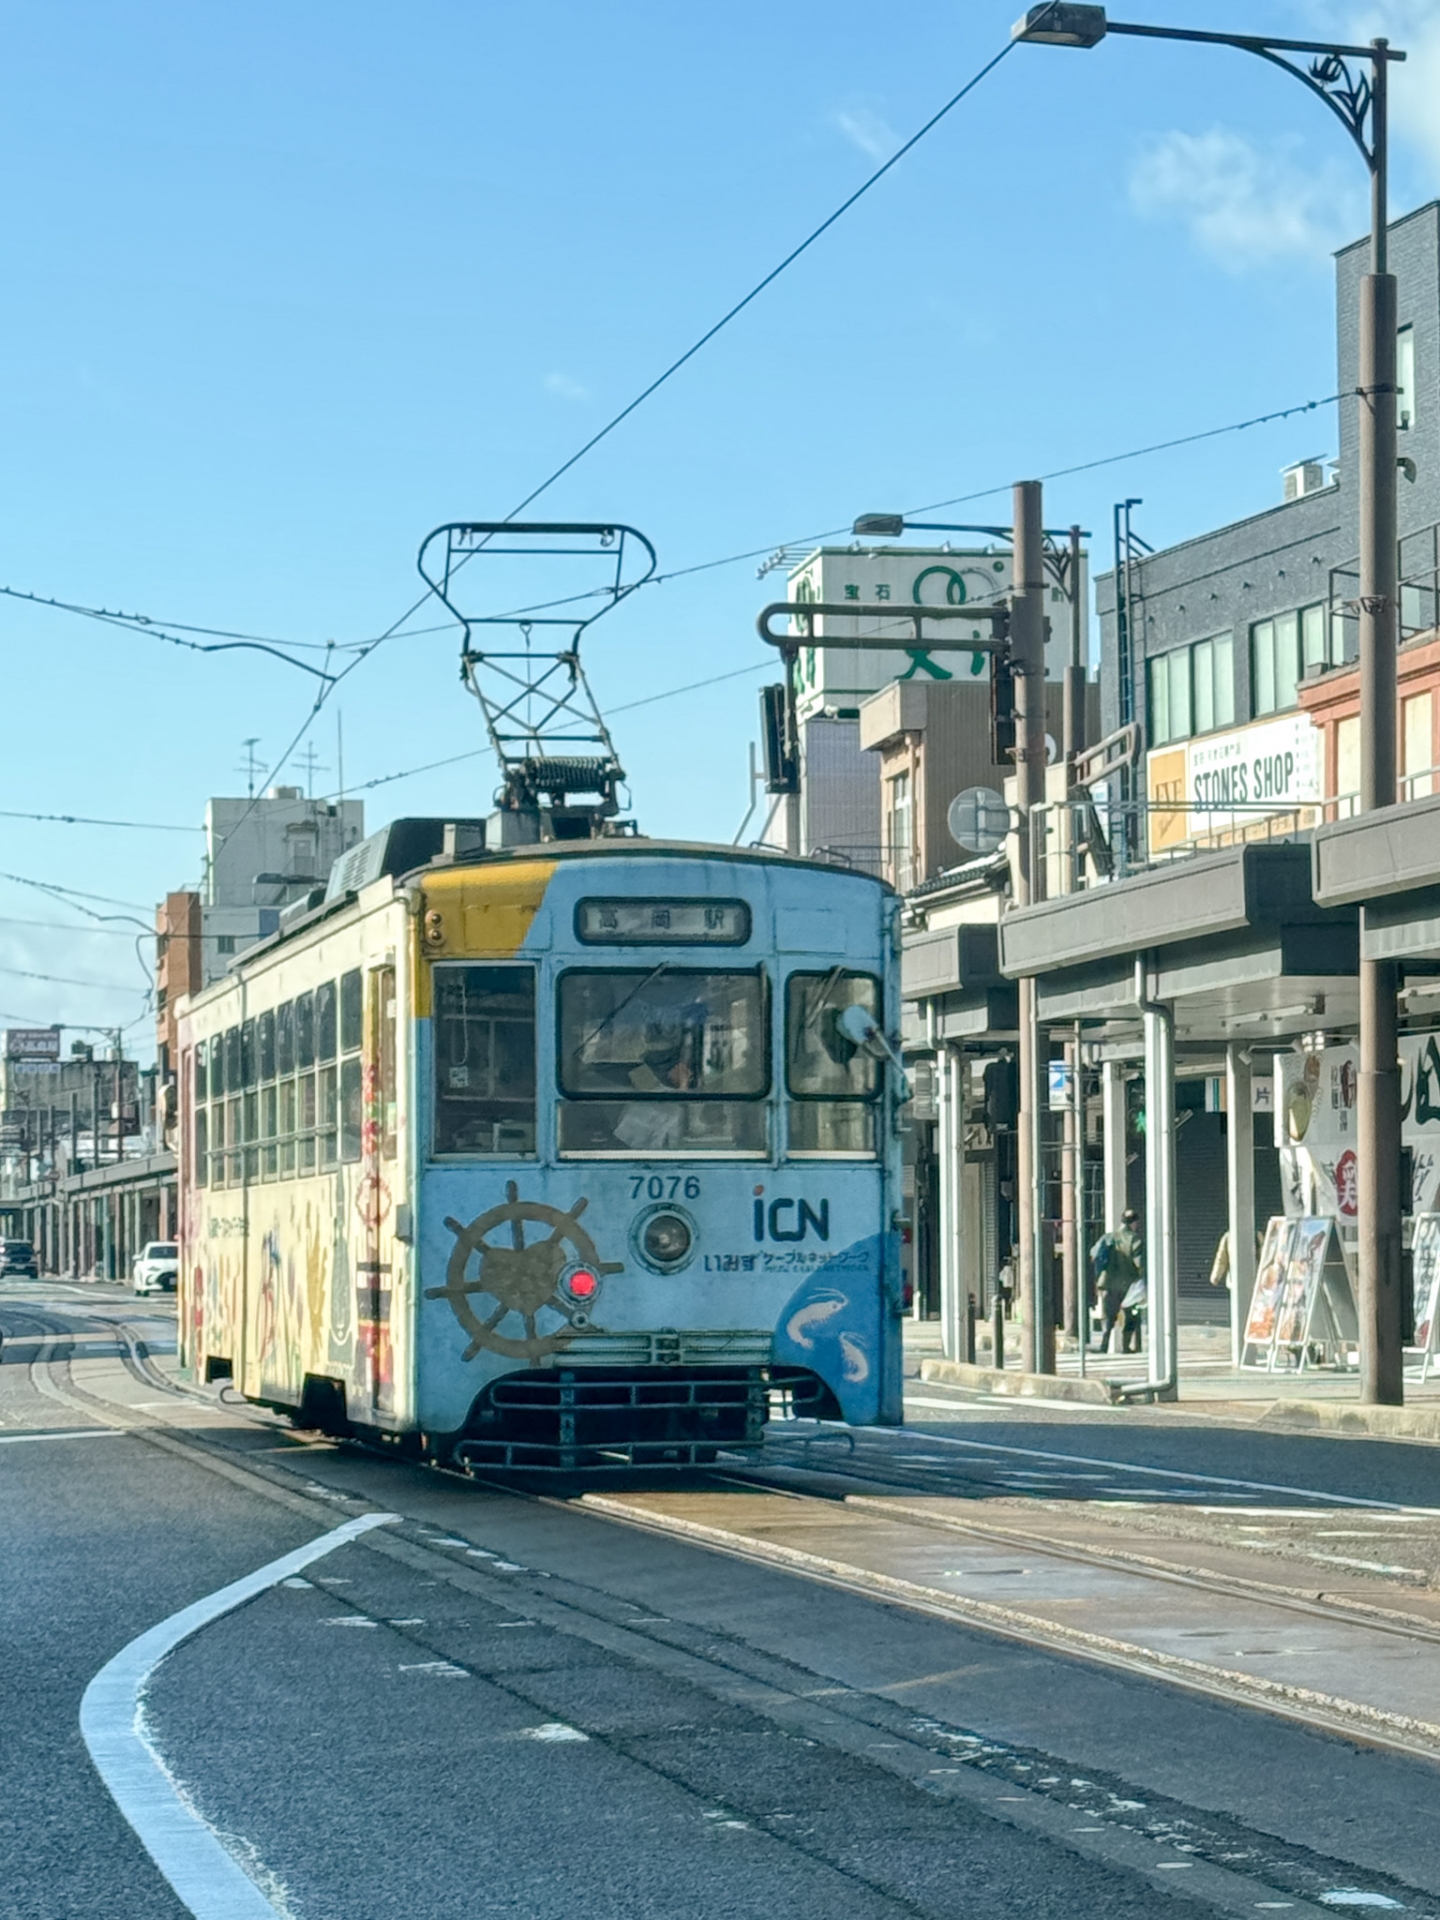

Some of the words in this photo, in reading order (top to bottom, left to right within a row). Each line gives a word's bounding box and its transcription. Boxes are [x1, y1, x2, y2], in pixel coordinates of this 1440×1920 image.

[844, 584, 891, 601] 宝石
[1194, 762, 1248, 814] STONES
[1253, 751, 1294, 800] SHOP
[628, 1175, 700, 1199] 7076
